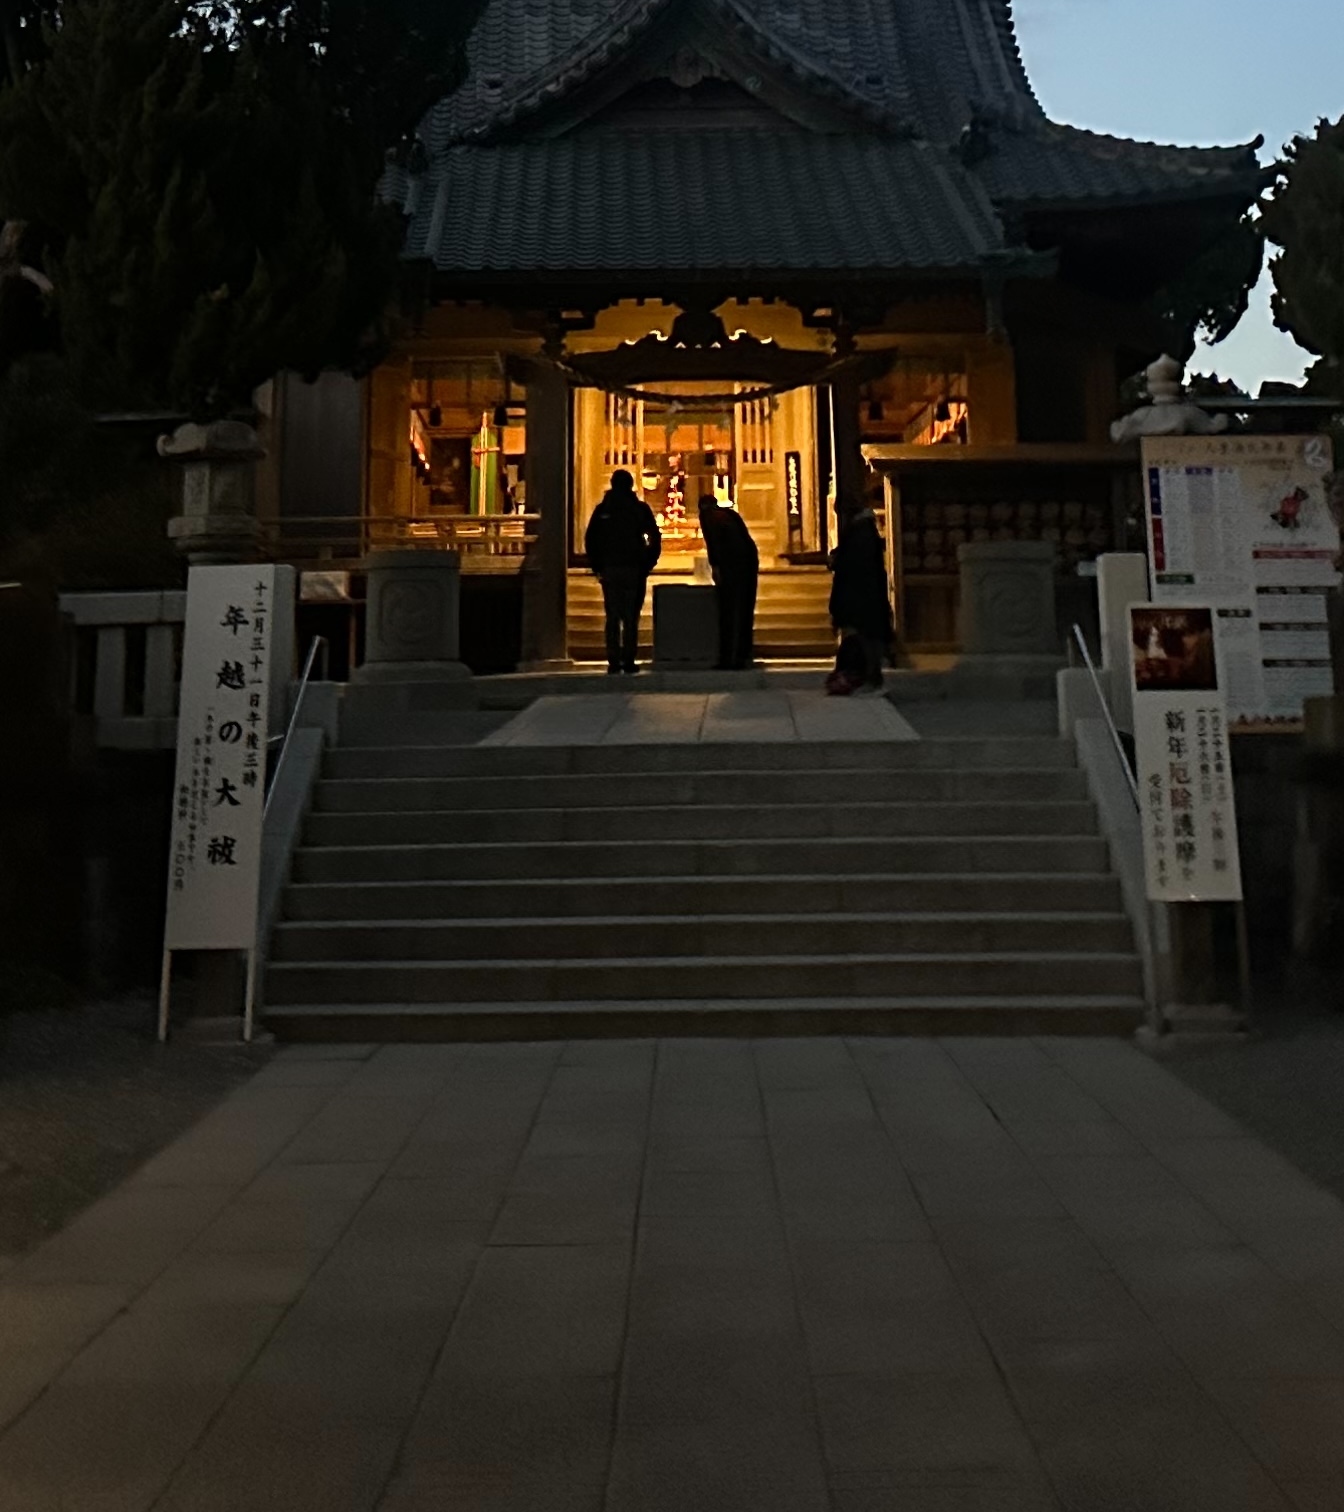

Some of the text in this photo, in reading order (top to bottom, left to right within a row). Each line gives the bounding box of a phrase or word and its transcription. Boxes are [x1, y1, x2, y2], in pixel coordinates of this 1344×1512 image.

[207, 604, 249, 865] 年越の大祓
[243, 581, 268, 788] 十二月三十一日午後三時
